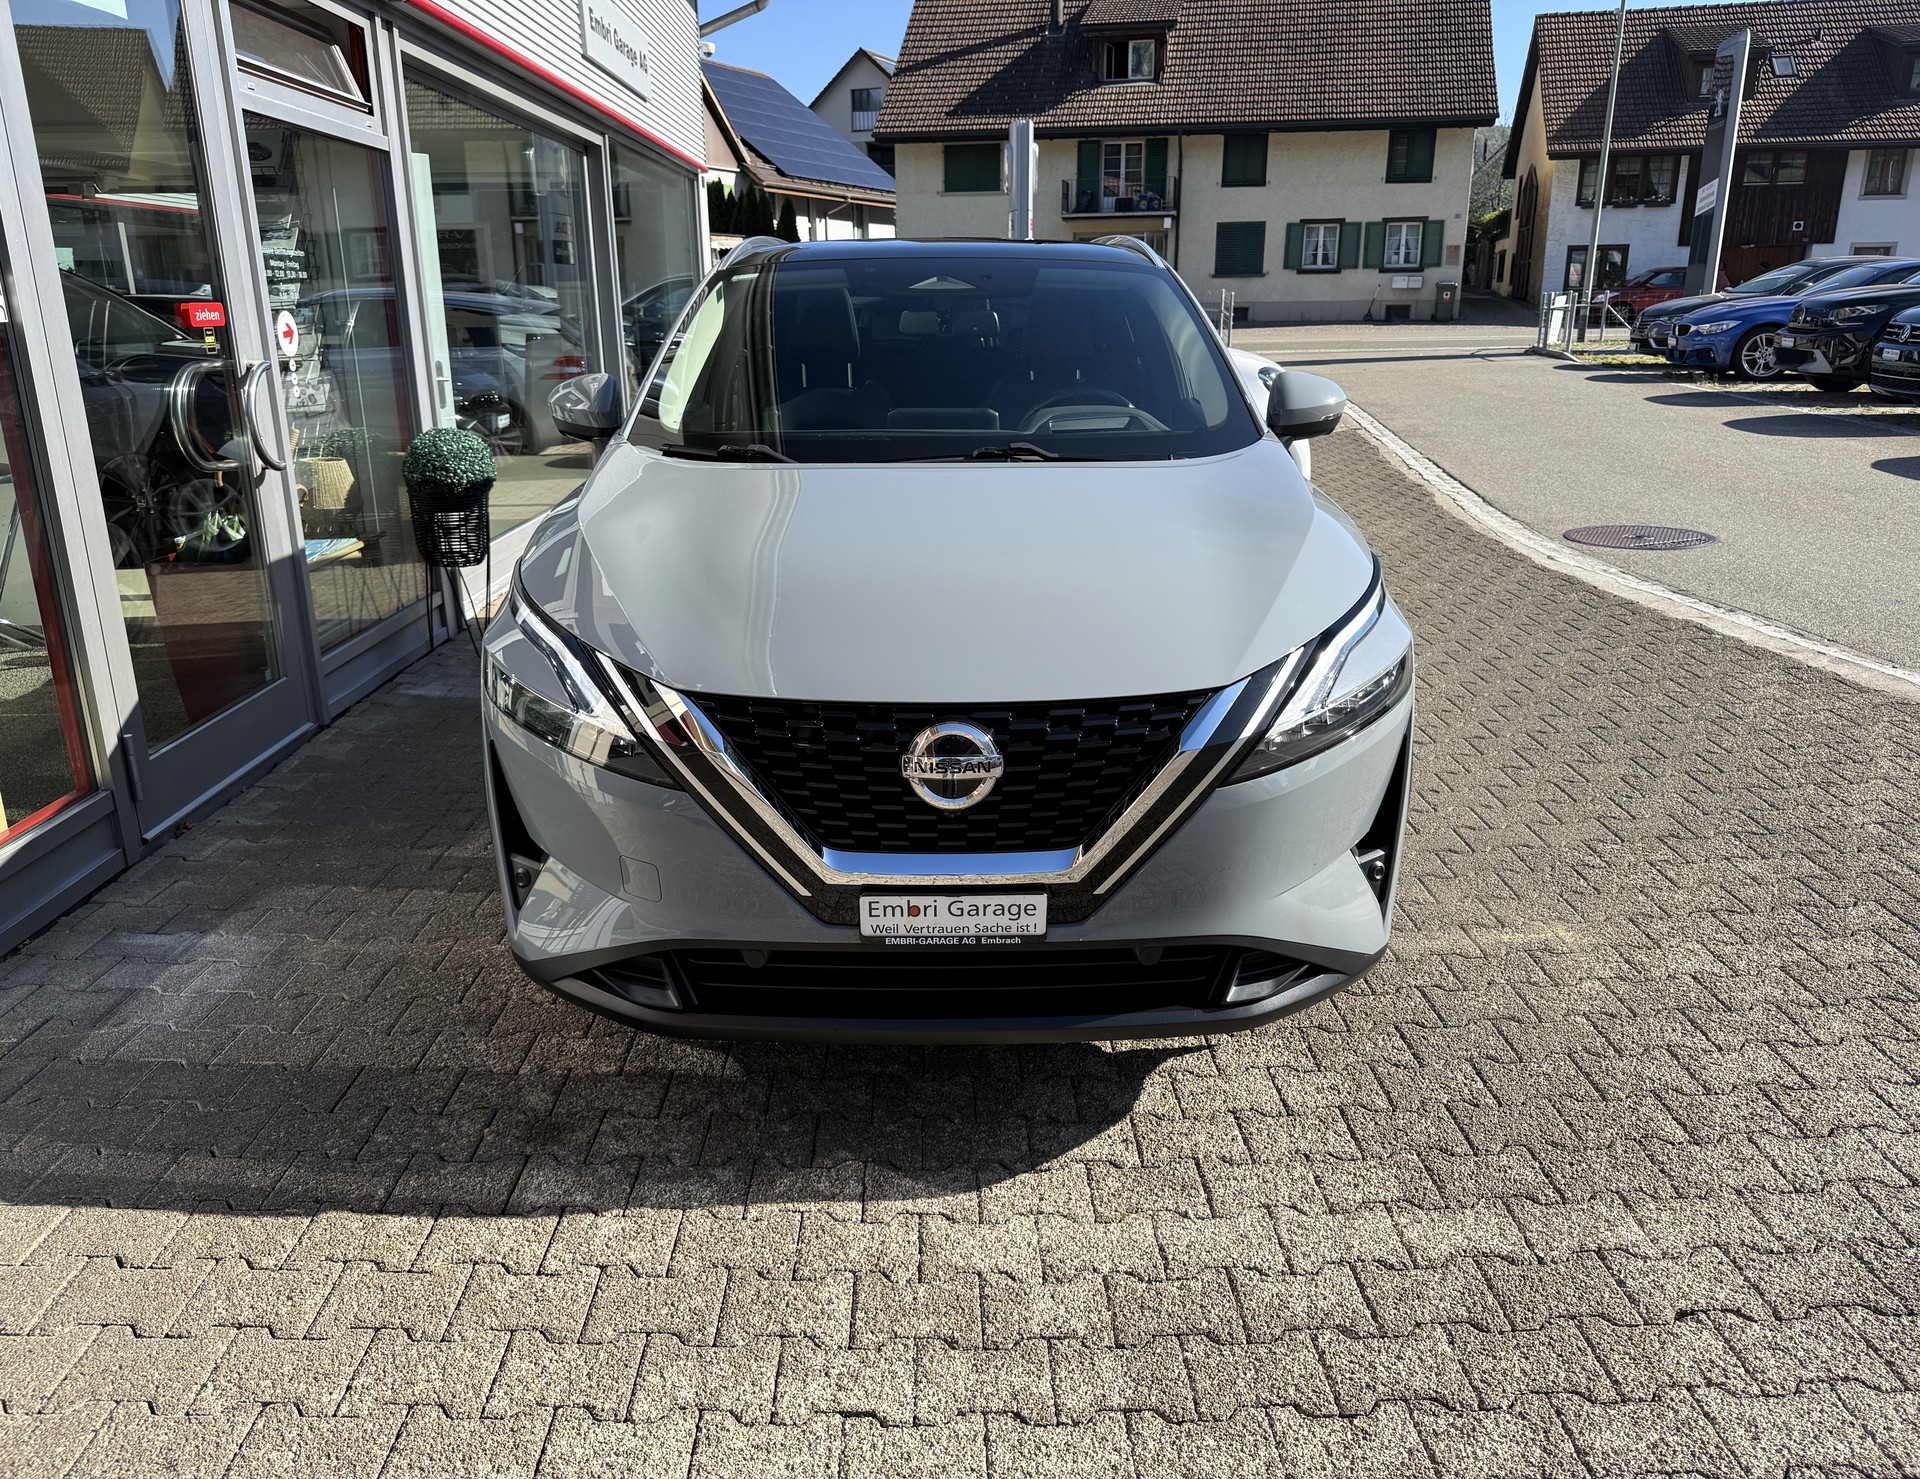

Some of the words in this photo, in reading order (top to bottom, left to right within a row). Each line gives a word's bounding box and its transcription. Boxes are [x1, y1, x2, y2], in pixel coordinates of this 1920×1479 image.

[588, 6, 613, 47] Embri
[613, 27, 638, 68] Garage
[639, 49, 649, 75] AG
[195, 308, 220, 321] ziehen
[914, 761, 992, 774] NISSAN
[868, 899, 938, 918] Embri
[947, 899, 1037, 921] Garage
[870, 923, 899, 934] Weil
[903, 923, 970, 934] Vertrauen
[974, 922, 1012, 934] Sache
[885, 937, 960, 945] EMBRI-GARAGE
[961, 937, 976, 945] AG
[981, 936, 1021, 945] Embrach
